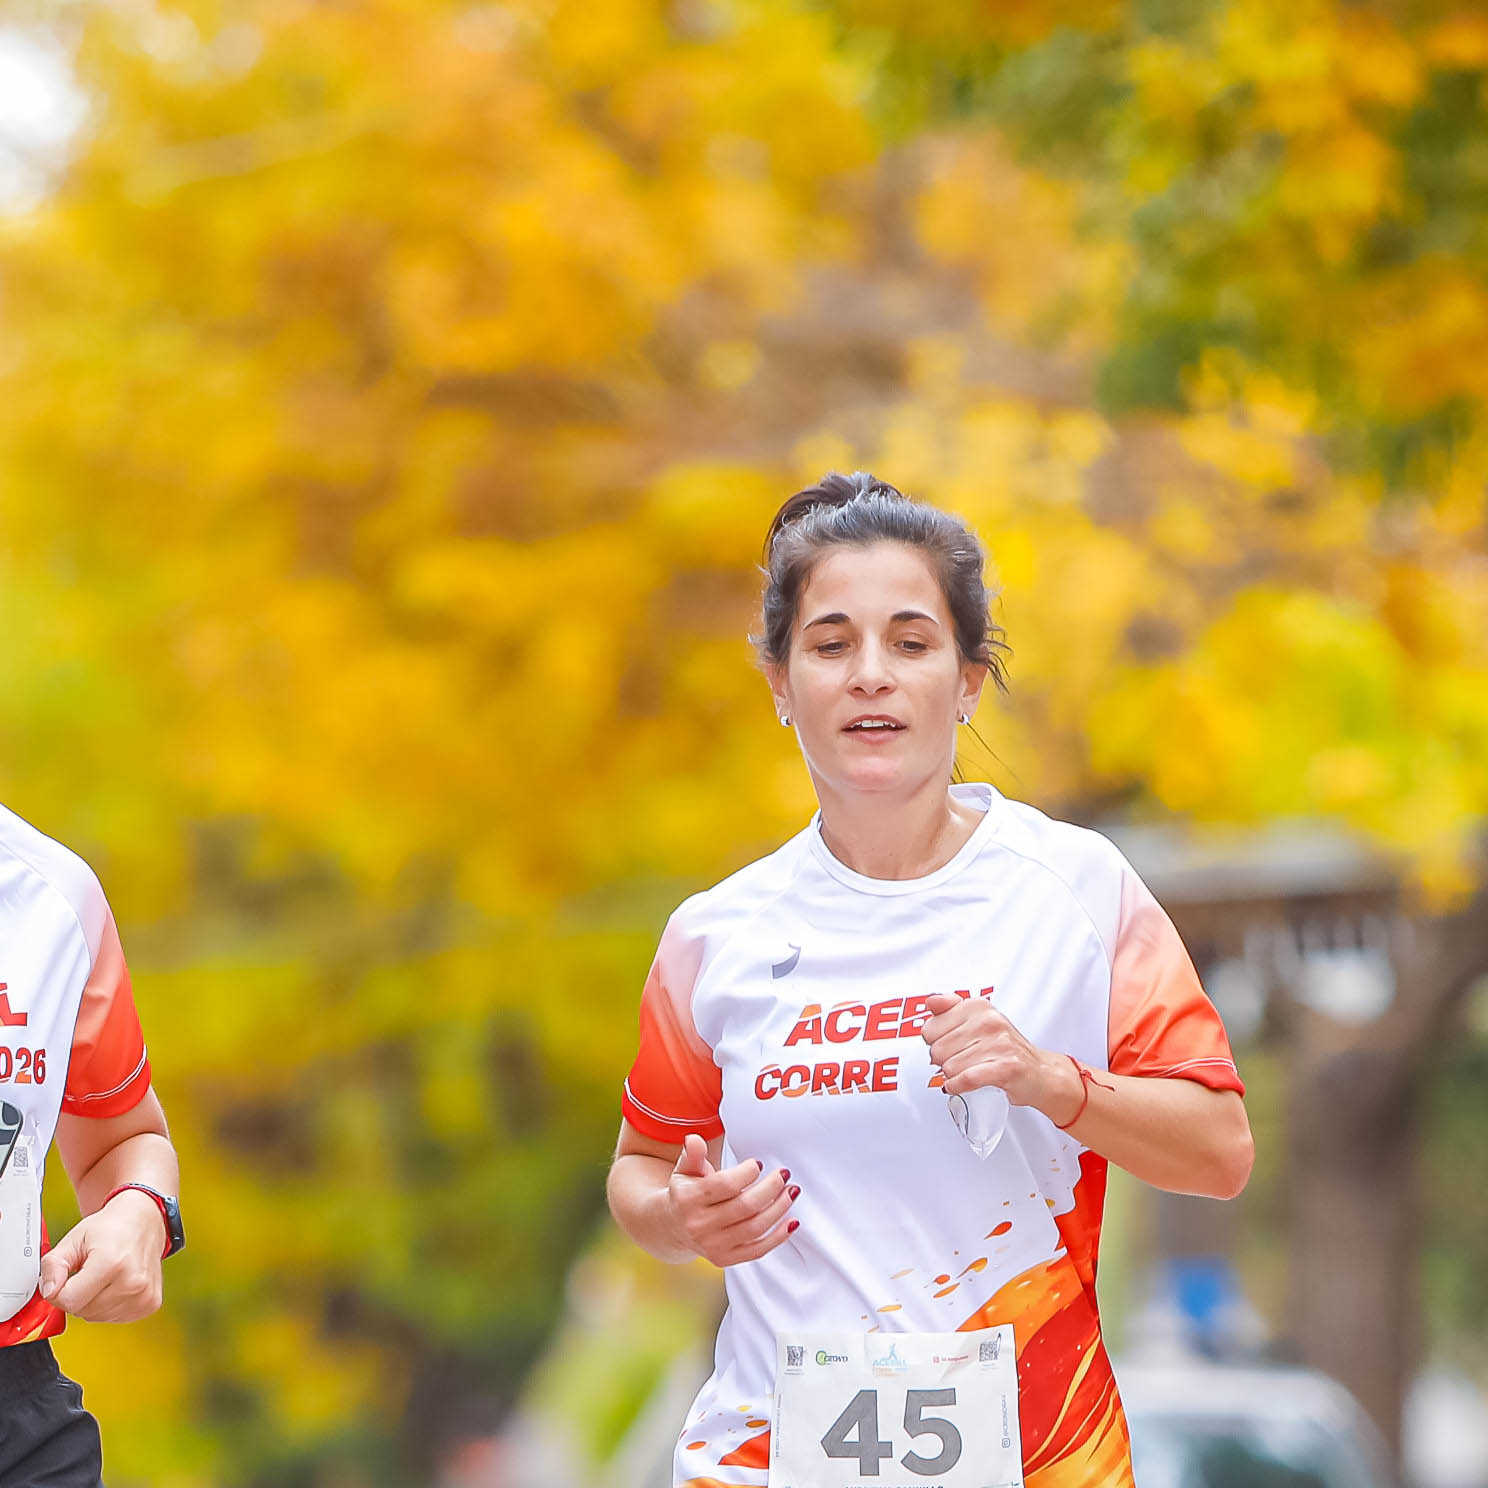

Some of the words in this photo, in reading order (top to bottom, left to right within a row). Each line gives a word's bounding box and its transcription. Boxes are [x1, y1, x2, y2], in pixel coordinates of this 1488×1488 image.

[783, 985, 995, 1047] ACEB
[754, 1056, 900, 1101] CORRE
[820, 1387, 963, 1477] 45
